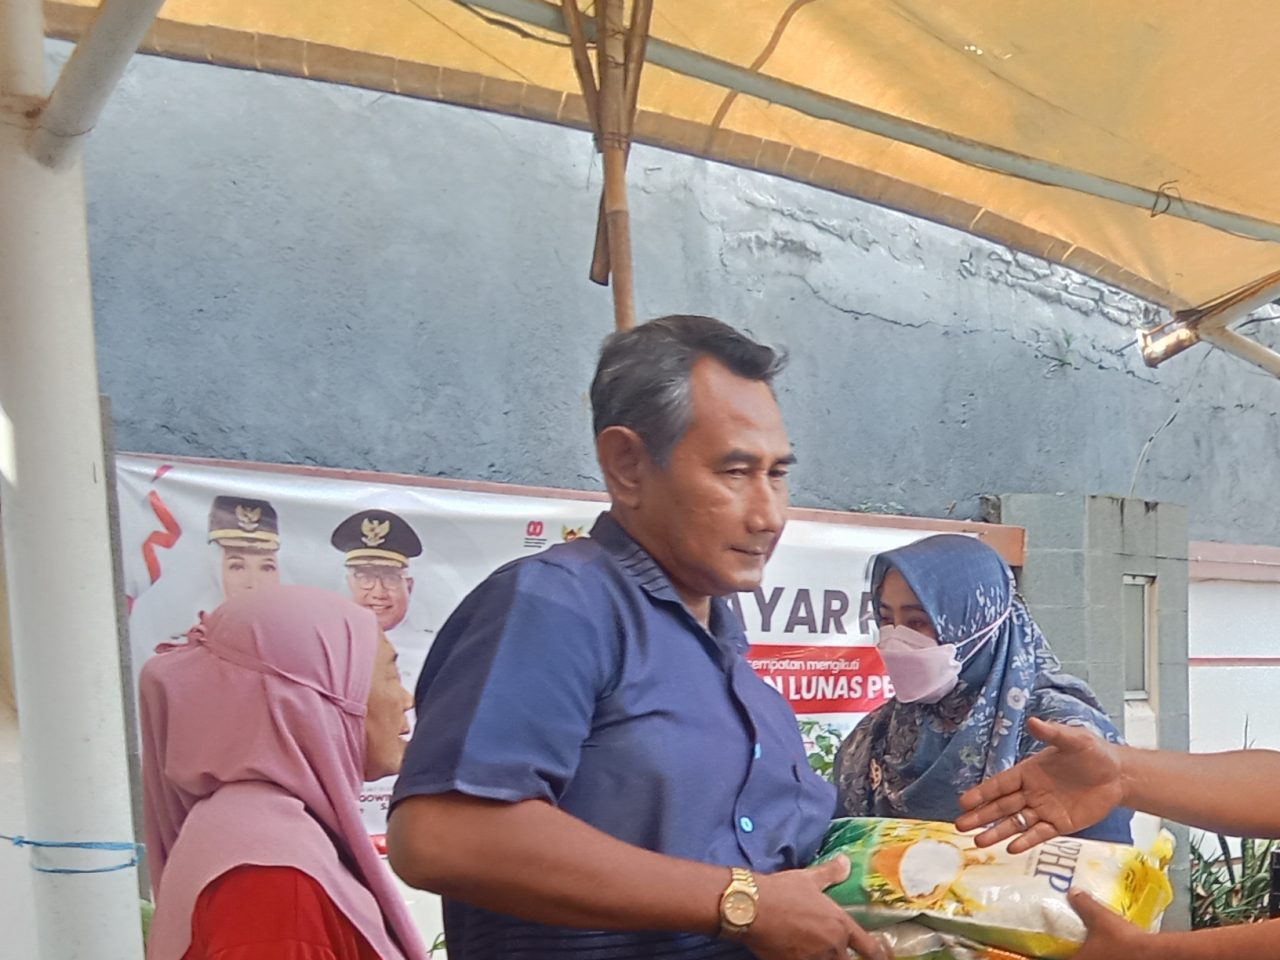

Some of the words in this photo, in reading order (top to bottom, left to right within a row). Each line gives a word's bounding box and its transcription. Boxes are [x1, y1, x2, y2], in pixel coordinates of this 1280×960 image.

[733, 587, 848, 634] YAR
[807, 658, 860, 674] mengikuti
[789, 675, 863, 700] LUNAS
